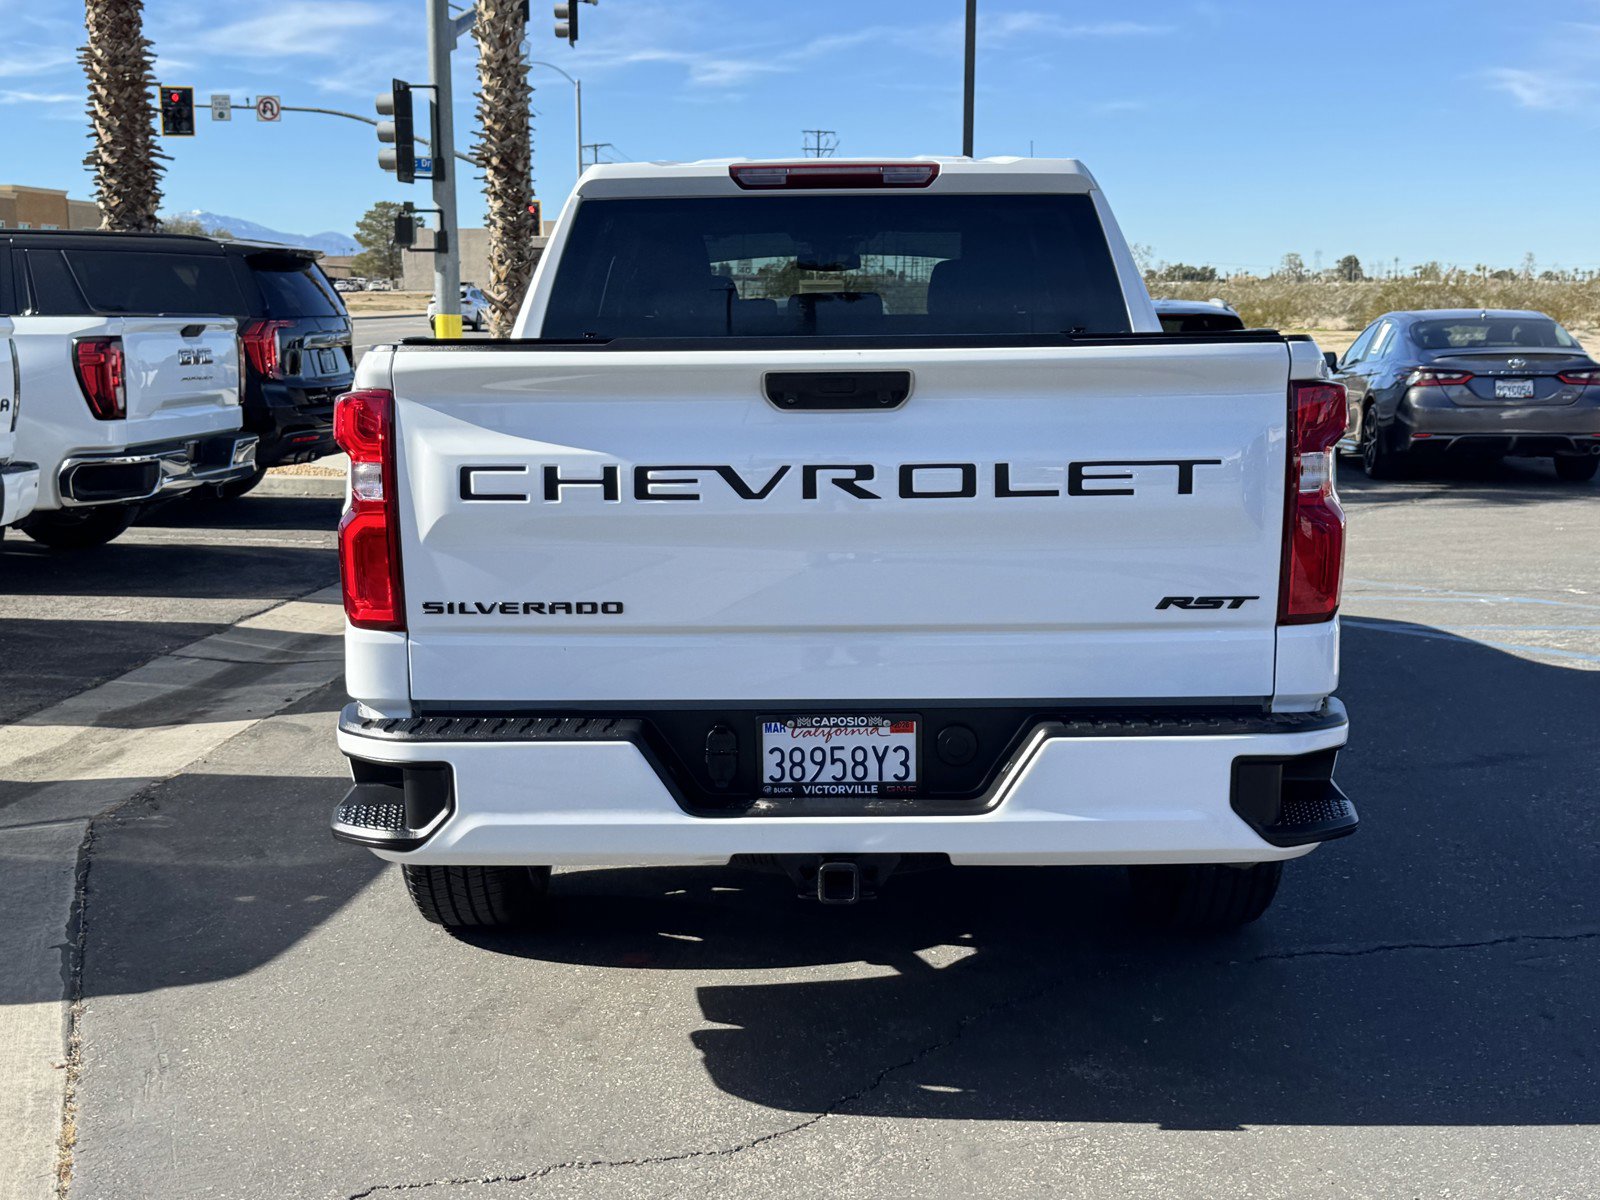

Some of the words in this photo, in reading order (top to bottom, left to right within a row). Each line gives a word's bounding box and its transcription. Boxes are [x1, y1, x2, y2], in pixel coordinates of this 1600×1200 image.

[459, 459, 1222, 501] CHEVROLET
[422, 601, 624, 615] SILVERADO
[1155, 596, 1260, 610] RST
[812, 716, 868, 727] CAPOSIO
[768, 745, 911, 782] 38958Y3
[773, 786, 793, 794] BUICK
[802, 784, 879, 795] VICTORVILLE
[886, 785, 917, 793] GMC
